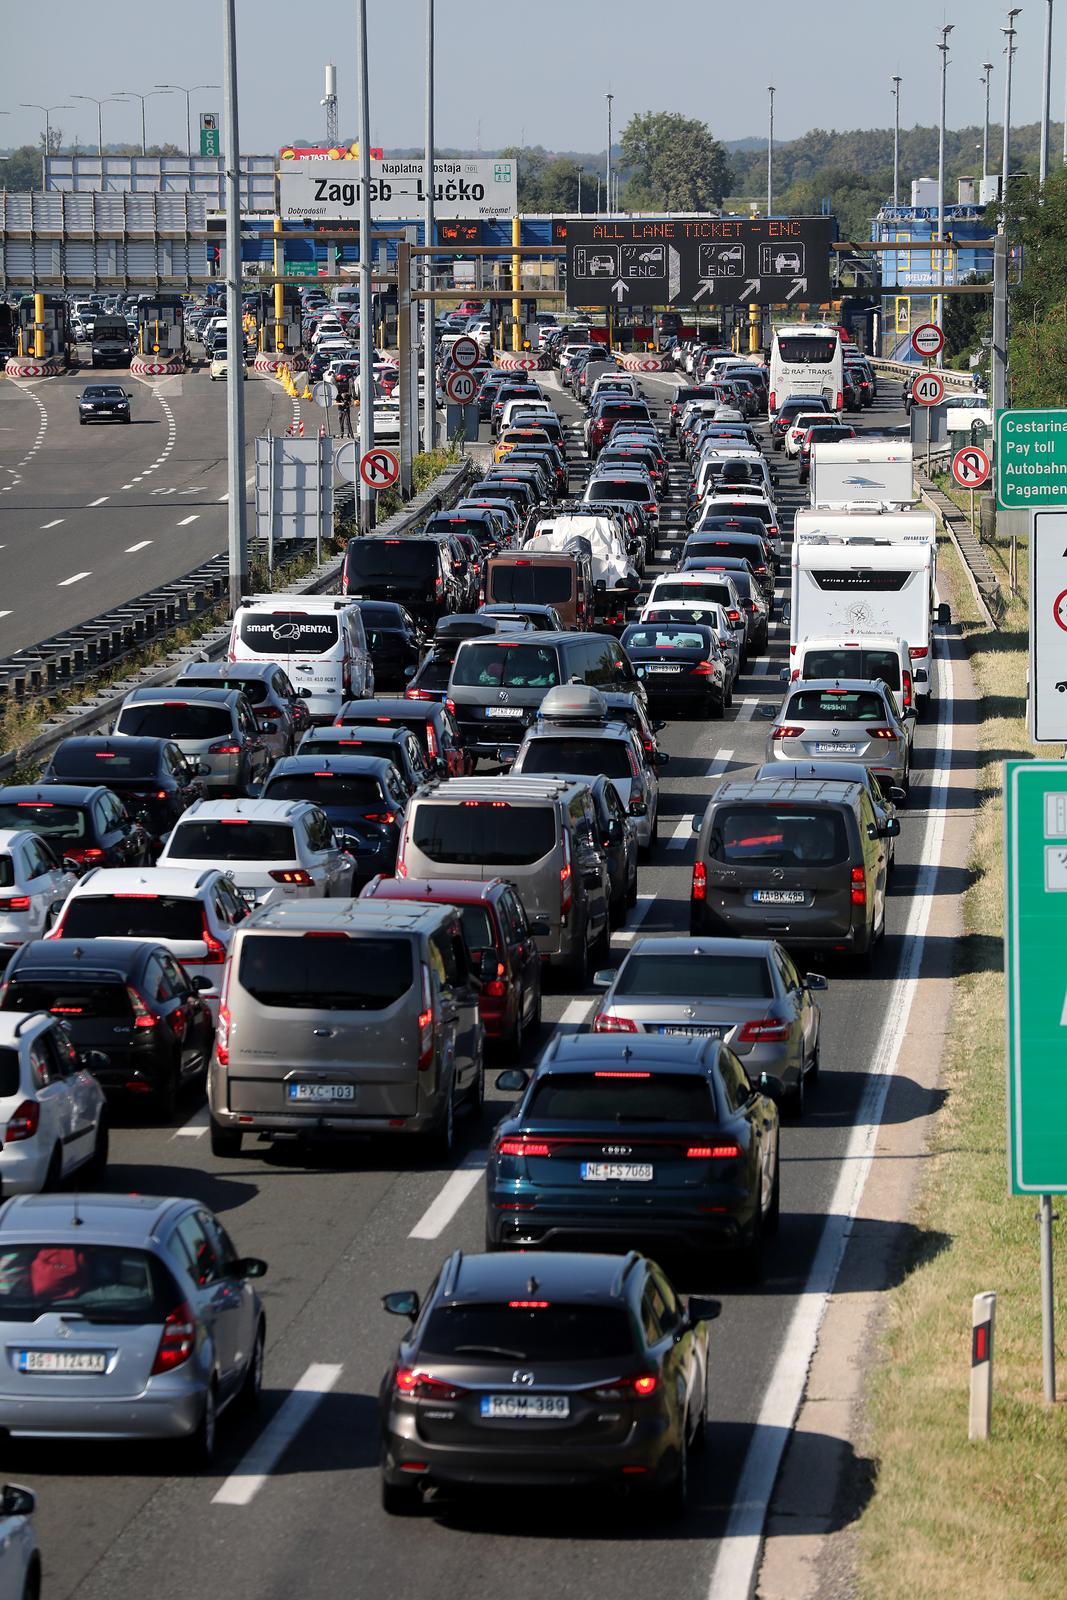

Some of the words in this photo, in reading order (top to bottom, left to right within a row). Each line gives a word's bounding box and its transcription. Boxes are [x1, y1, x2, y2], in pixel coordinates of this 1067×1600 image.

[382, 164, 423, 174] Naplatna
[433, 163, 461, 174] ostaja
[417, 179, 485, 201] Lučko
[288, 207, 327, 215] Dobrodošli!
[479, 206, 511, 214] Welcome!
[593, 224, 625, 238] ALL
[632, 223, 675, 238] LANE
[683, 222, 743, 237] TICKET
[769, 222, 801, 236] ENC
[629, 265, 657, 277] ENC
[708, 264, 736, 276] ENC
[455, 380, 471, 395] 40
[920, 382, 938, 397] 40
[1006, 420, 1067, 433] Cestarina
[1006, 441, 1030, 457] Pay
[1034, 440, 1055, 453] toll
[1006, 462, 1067, 475] Autobahn
[1006, 483, 1067, 498] Pagamen
[246, 623, 276, 632] smart
[299, 624, 332, 634] RENTAL
[300, 1085, 352, 1098] RXC-103
[588, 1163, 601, 1176] NE
[609, 1164, 623, 1176] FS
